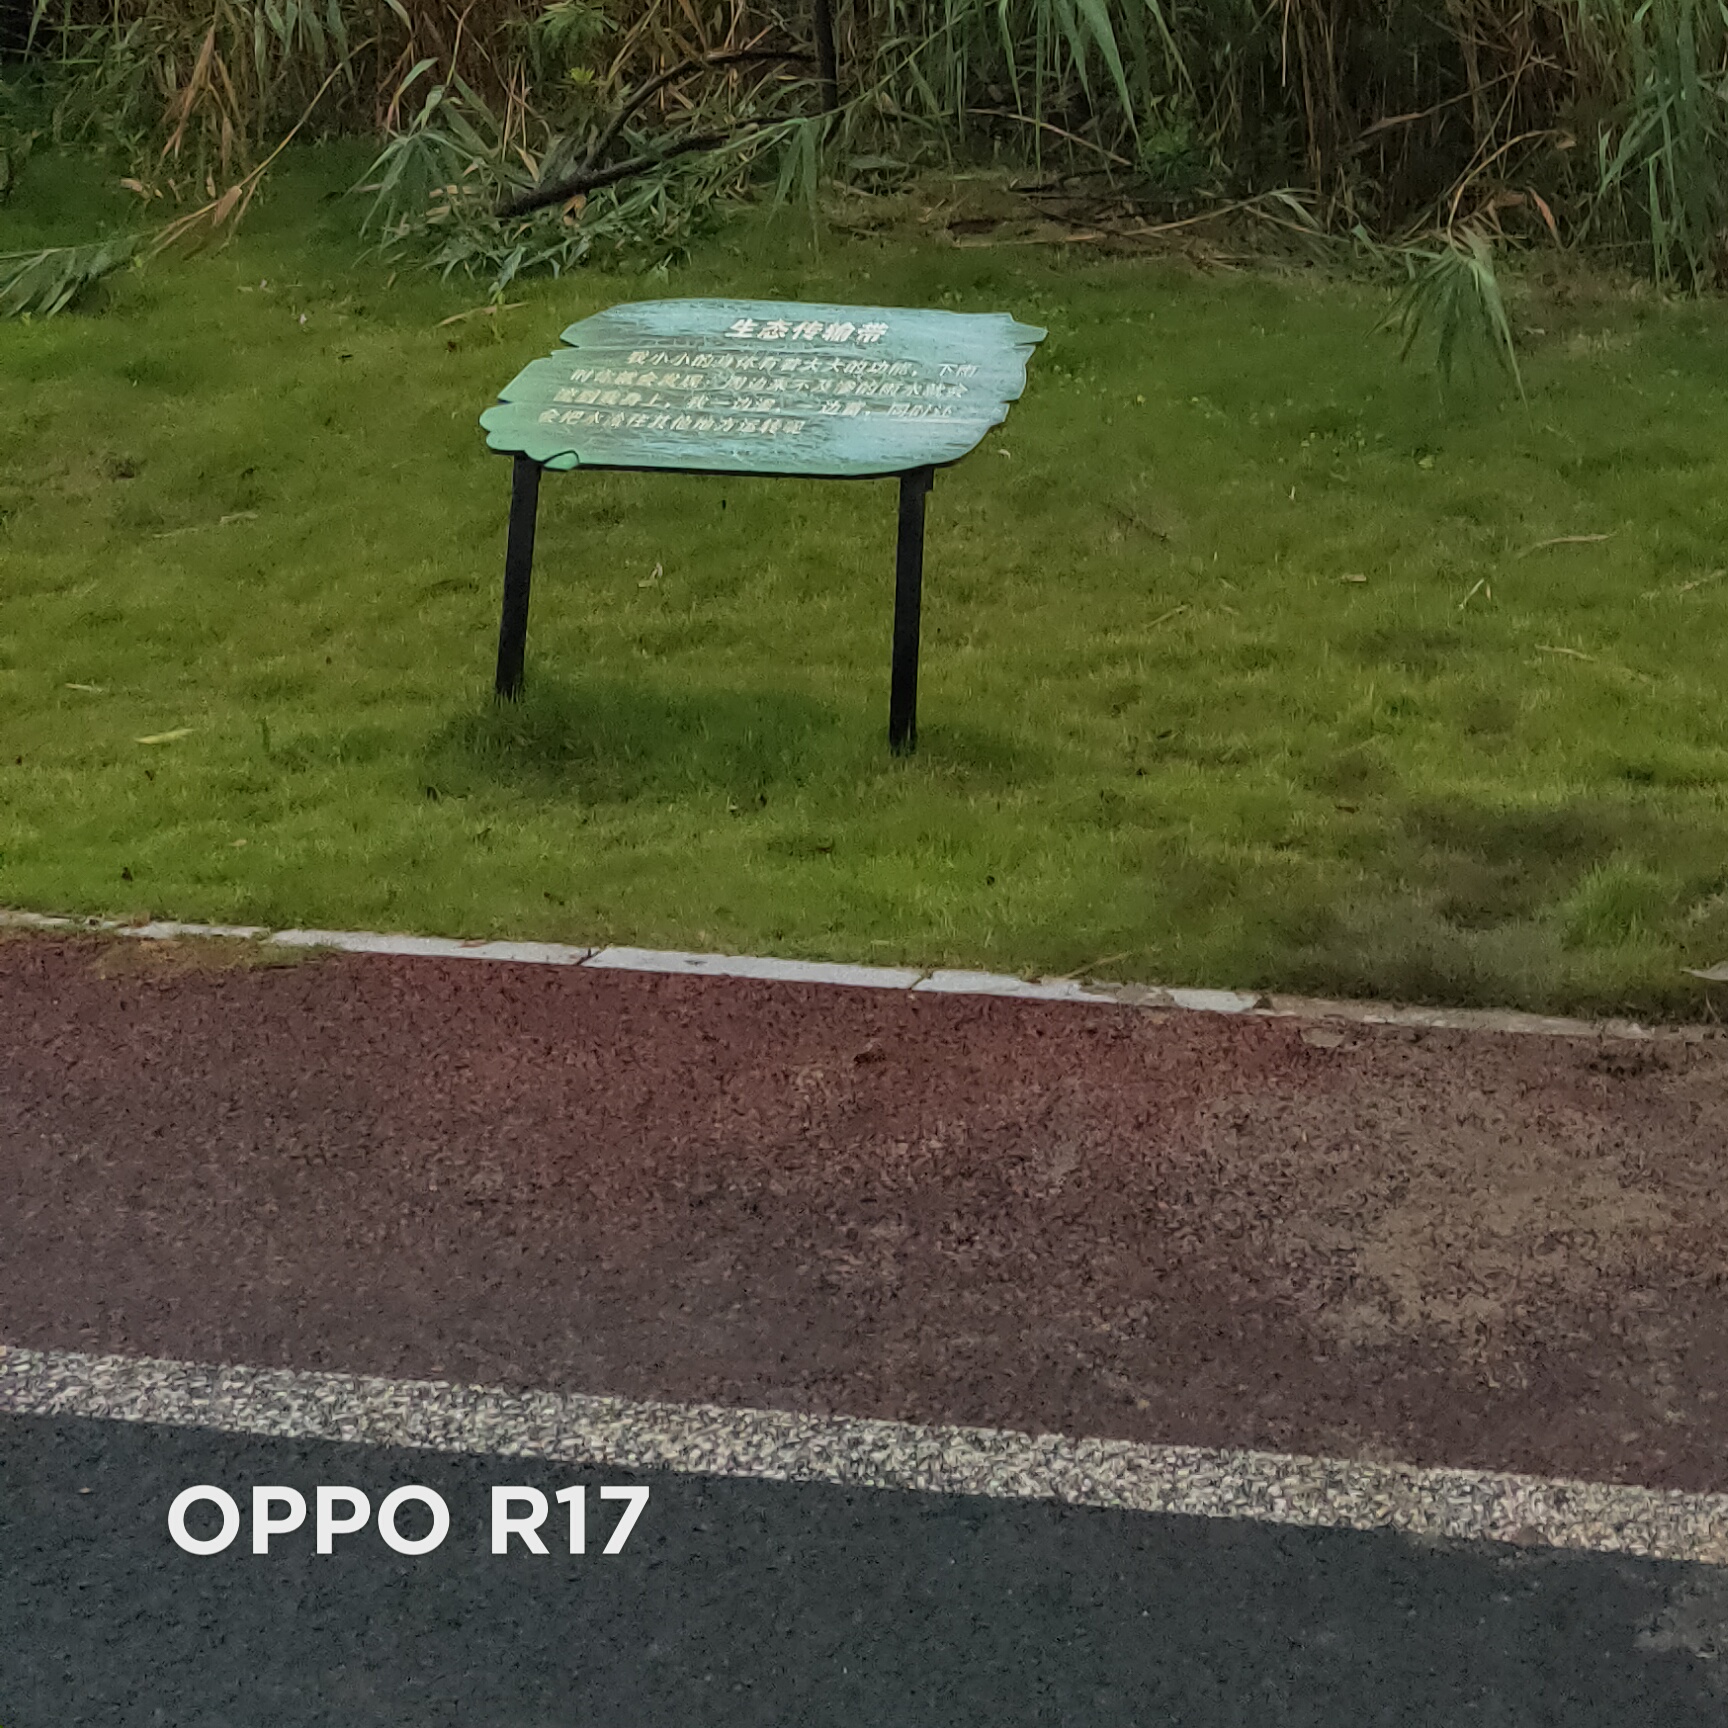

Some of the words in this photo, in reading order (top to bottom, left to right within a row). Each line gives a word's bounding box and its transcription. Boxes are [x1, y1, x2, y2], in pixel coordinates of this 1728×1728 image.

[726, 318, 889, 344] 生态传输带
